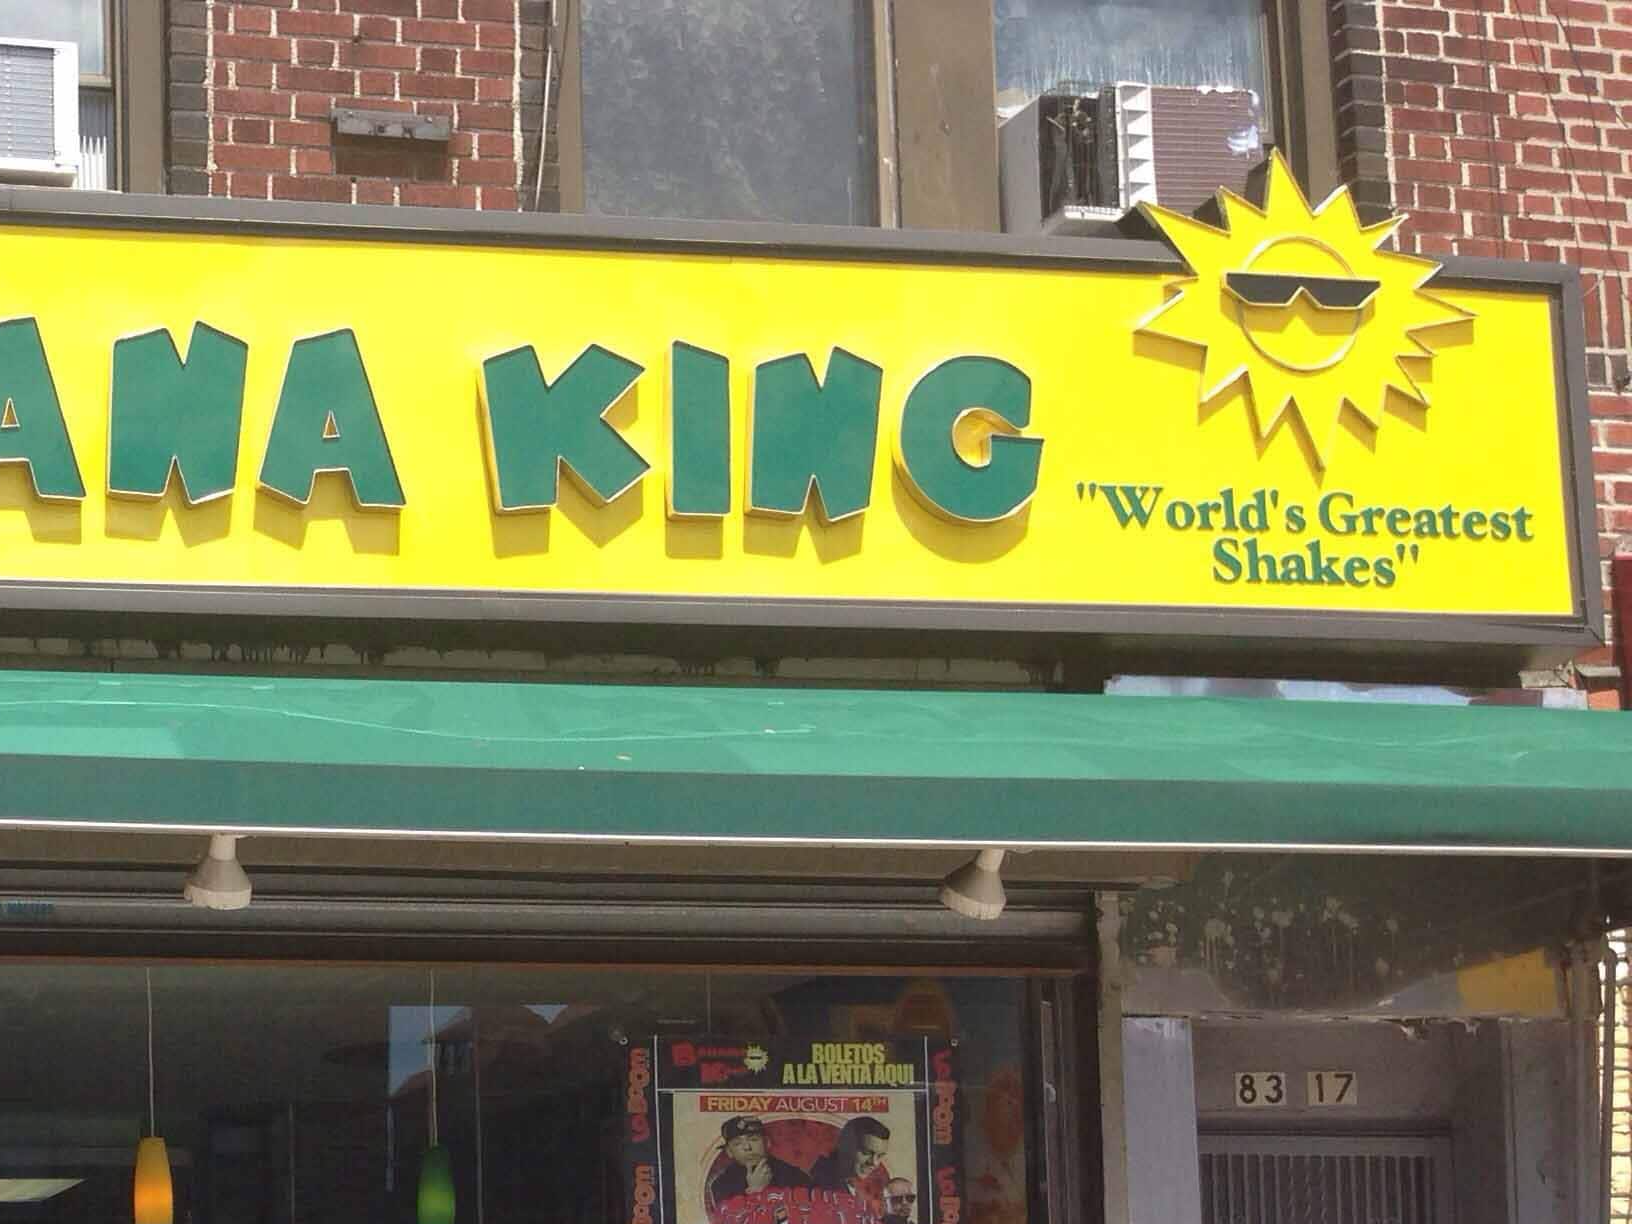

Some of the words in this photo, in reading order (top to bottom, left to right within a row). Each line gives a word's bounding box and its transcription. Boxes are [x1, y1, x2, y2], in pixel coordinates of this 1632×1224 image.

[479, 340, 1045, 522] KING
[1076, 482, 1307, 534] "World's
[1318, 492, 1534, 542] Greatest
[1213, 537, 1420, 588] Shakes"
[811, 1042, 886, 1065] BOLETOS
[782, 1064, 794, 1085] A
[796, 1063, 820, 1085] LA
[821, 1063, 872, 1085] VENTA
[873, 1063, 915, 1087] AQUI
[1239, 1074, 1283, 1104] 83
[1315, 1073, 1353, 1103] 17
[707, 1097, 770, 1112] FRIDAY
[775, 1098, 849, 1113] AUGUST
